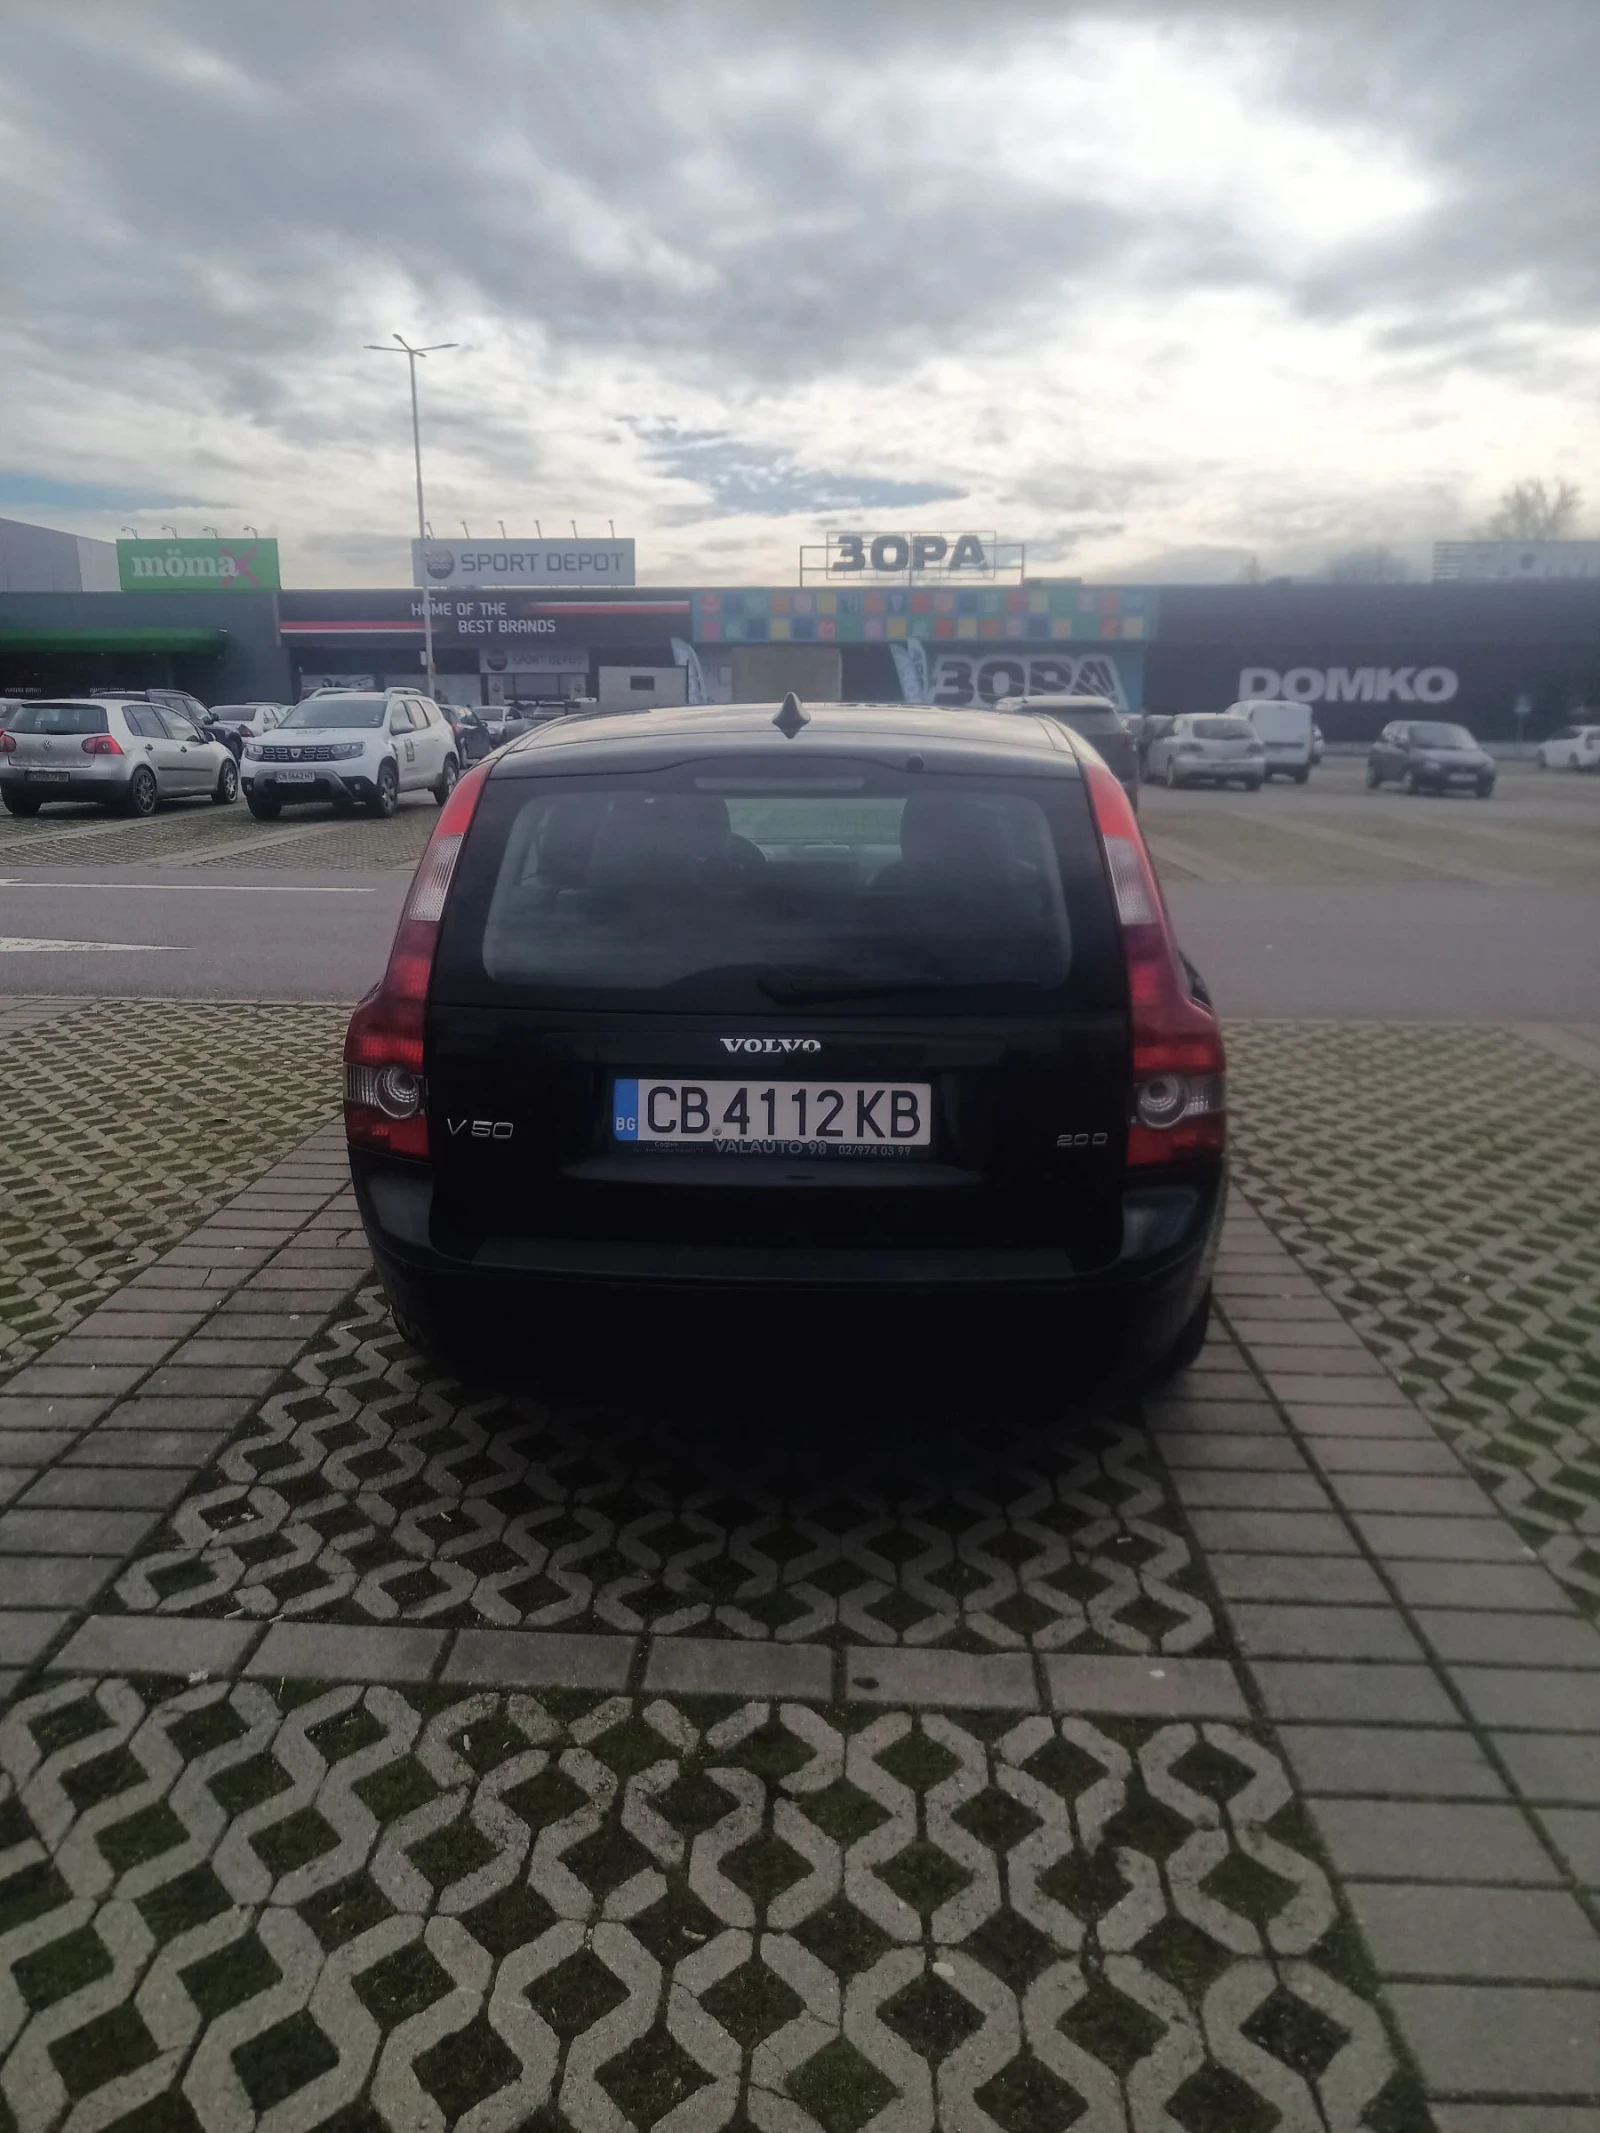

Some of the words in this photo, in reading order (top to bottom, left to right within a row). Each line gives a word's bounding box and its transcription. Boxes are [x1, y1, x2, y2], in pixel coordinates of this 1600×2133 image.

[831, 535, 989, 571] ЗОРА
[461, 553, 540, 572] SPORT
[546, 552, 624, 572] DEPOT
[456, 602, 475, 616] OF
[479, 602, 508, 616] THE
[458, 620, 494, 633] BEST
[499, 620, 557, 633] BRANDS
[1238, 667, 1459, 703] DOMKO
[719, 1038, 821, 1053] VOLVO
[616, 1116, 636, 1131] BG
[712, 1139, 803, 1154] VALAUTO
[808, 1140, 828, 1155] 98
[838, 1144, 878, 1156] 02/974
[880, 1146, 895, 1156] 03
[897, 1146, 912, 1156] 99
